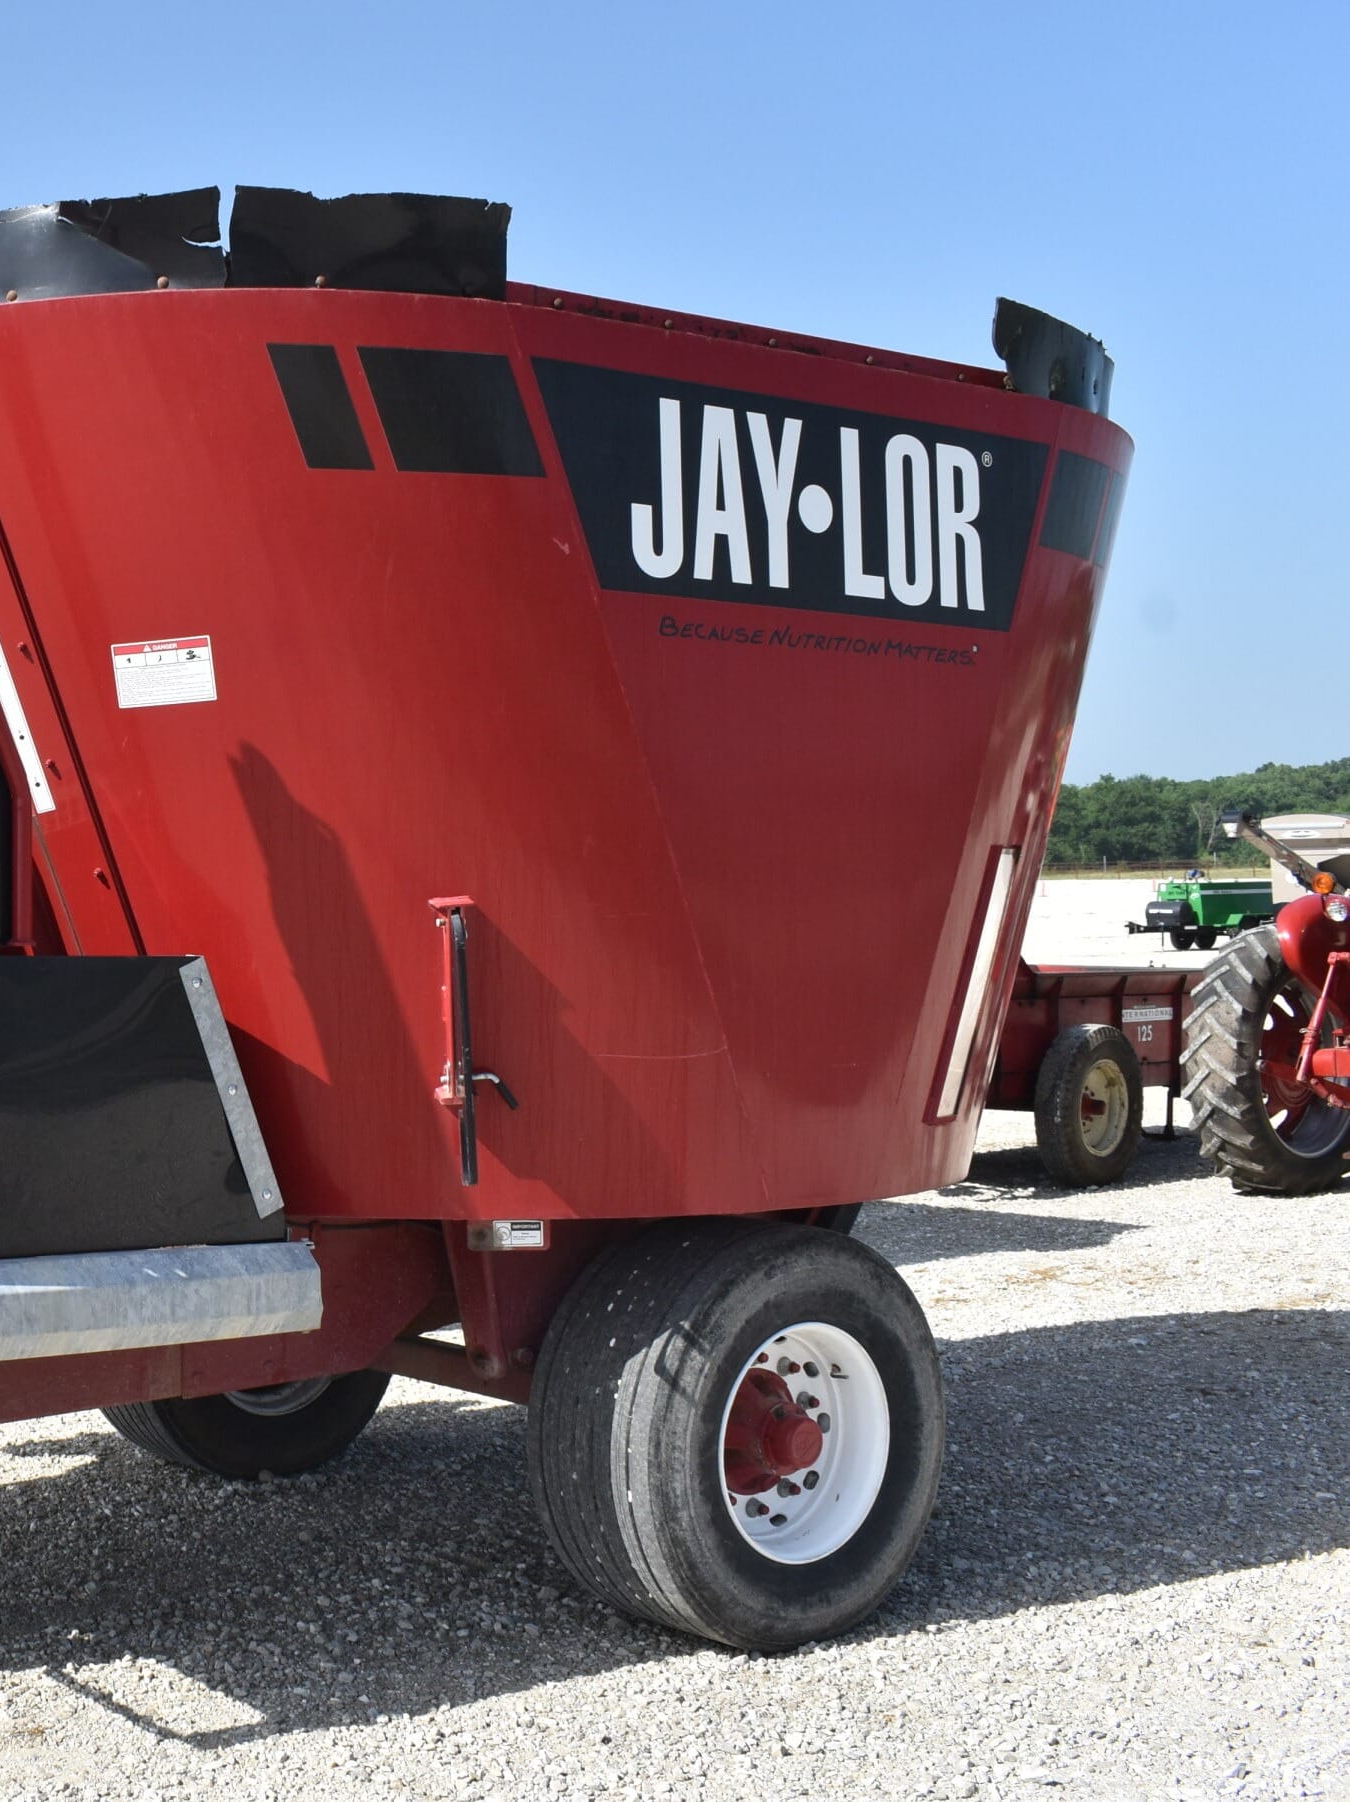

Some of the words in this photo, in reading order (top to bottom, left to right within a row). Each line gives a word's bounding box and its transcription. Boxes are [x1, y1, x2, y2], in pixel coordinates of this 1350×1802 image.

[658, 614, 763, 645] BECAUSE
[768, 625, 881, 656] NUTRITION
[152, 643, 178, 651] DANGER
[1137, 1025, 1153, 1042] 125
